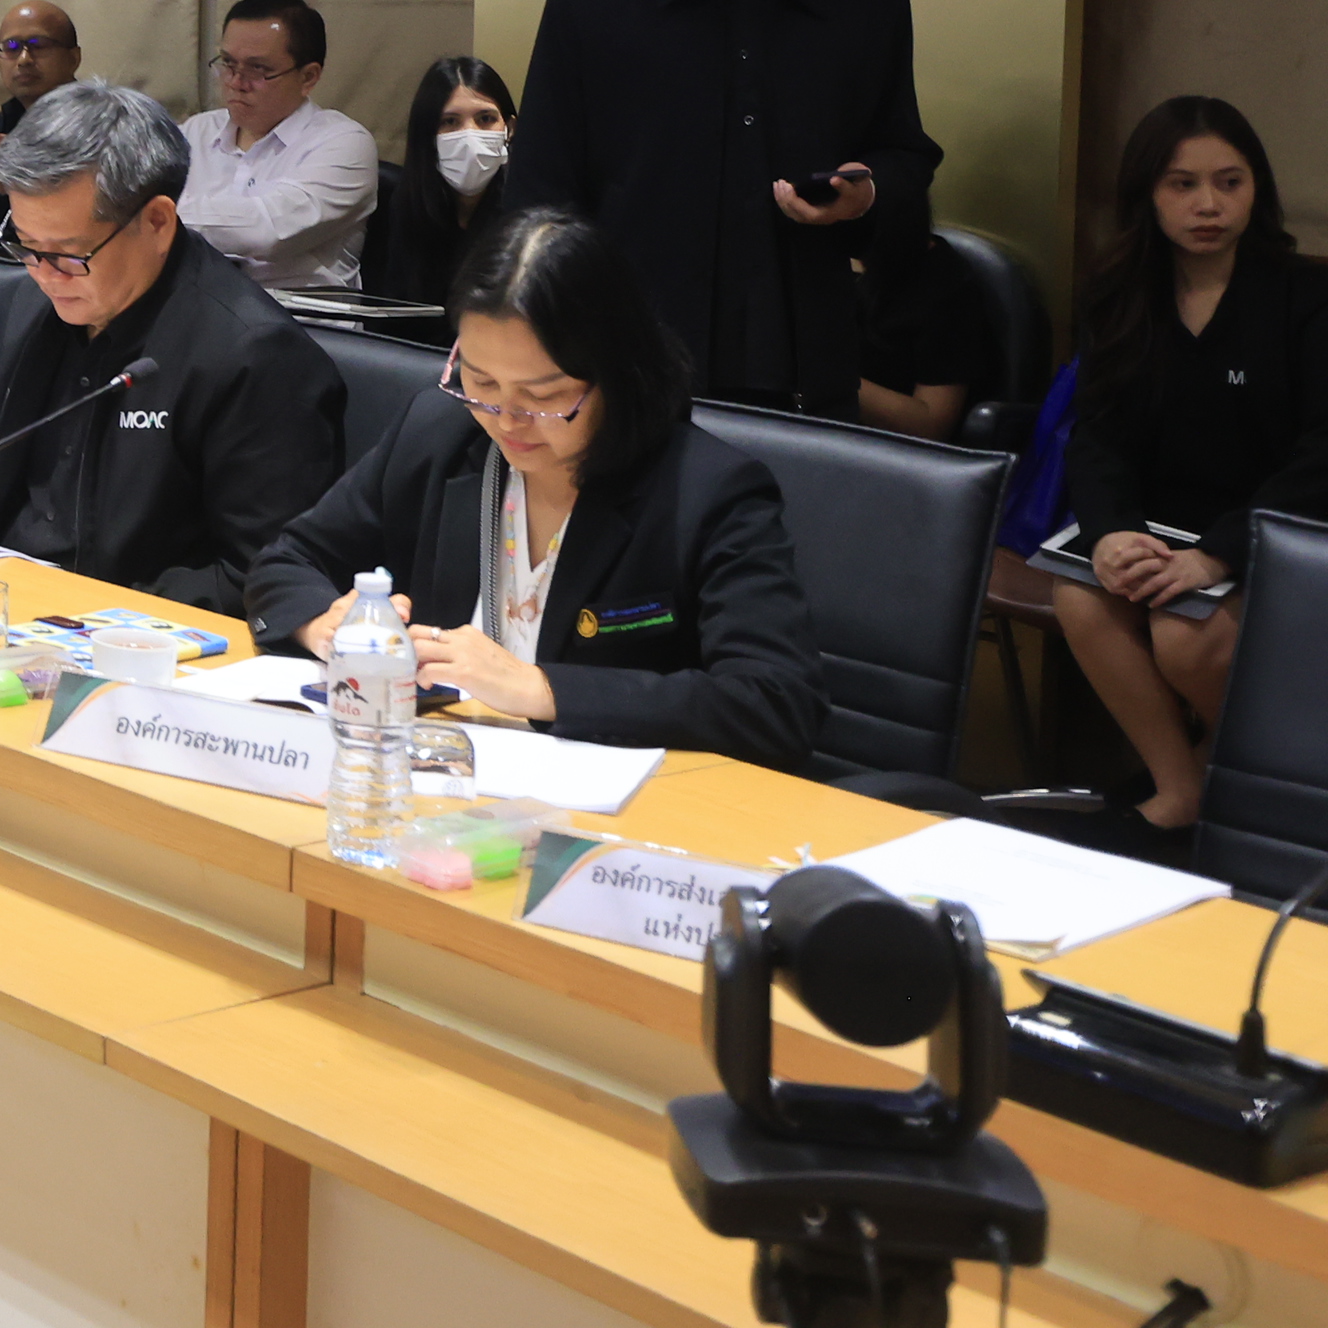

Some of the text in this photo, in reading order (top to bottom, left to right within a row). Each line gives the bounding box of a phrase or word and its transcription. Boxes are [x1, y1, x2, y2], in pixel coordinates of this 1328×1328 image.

[119, 410, 169, 429] MOAC
[116, 714, 310, 770] องค์การสะพานปลา
[644, 913, 716, 947] แห่งป
